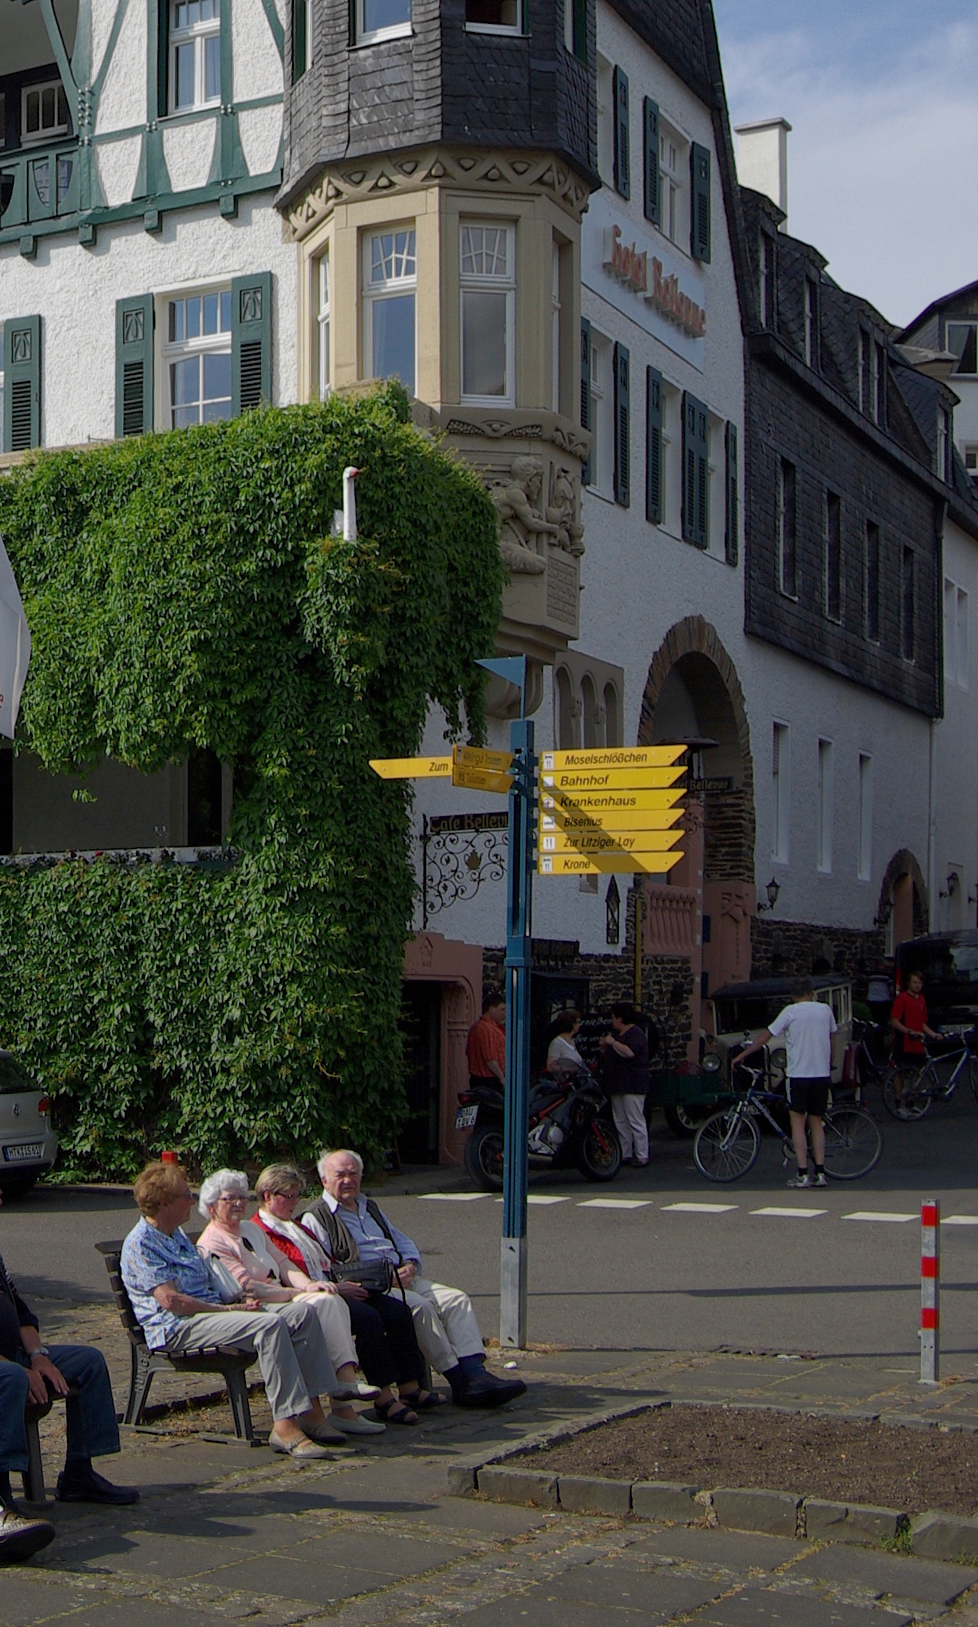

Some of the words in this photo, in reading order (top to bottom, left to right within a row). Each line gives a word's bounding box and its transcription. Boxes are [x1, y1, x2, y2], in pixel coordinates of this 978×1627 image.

[564, 752, 648, 765] Moselschlößchen
[428, 761, 449, 772] Zum
[560, 774, 610, 786] Bahnhof
[560, 796, 637, 808] Krankenhaus
[563, 816, 603, 828] Bisenius
[563, 837, 579, 848] Zur
[580, 837, 616, 850] Litziger
[617, 836, 635, 848] Lay
[563, 859, 591, 870] Krone
